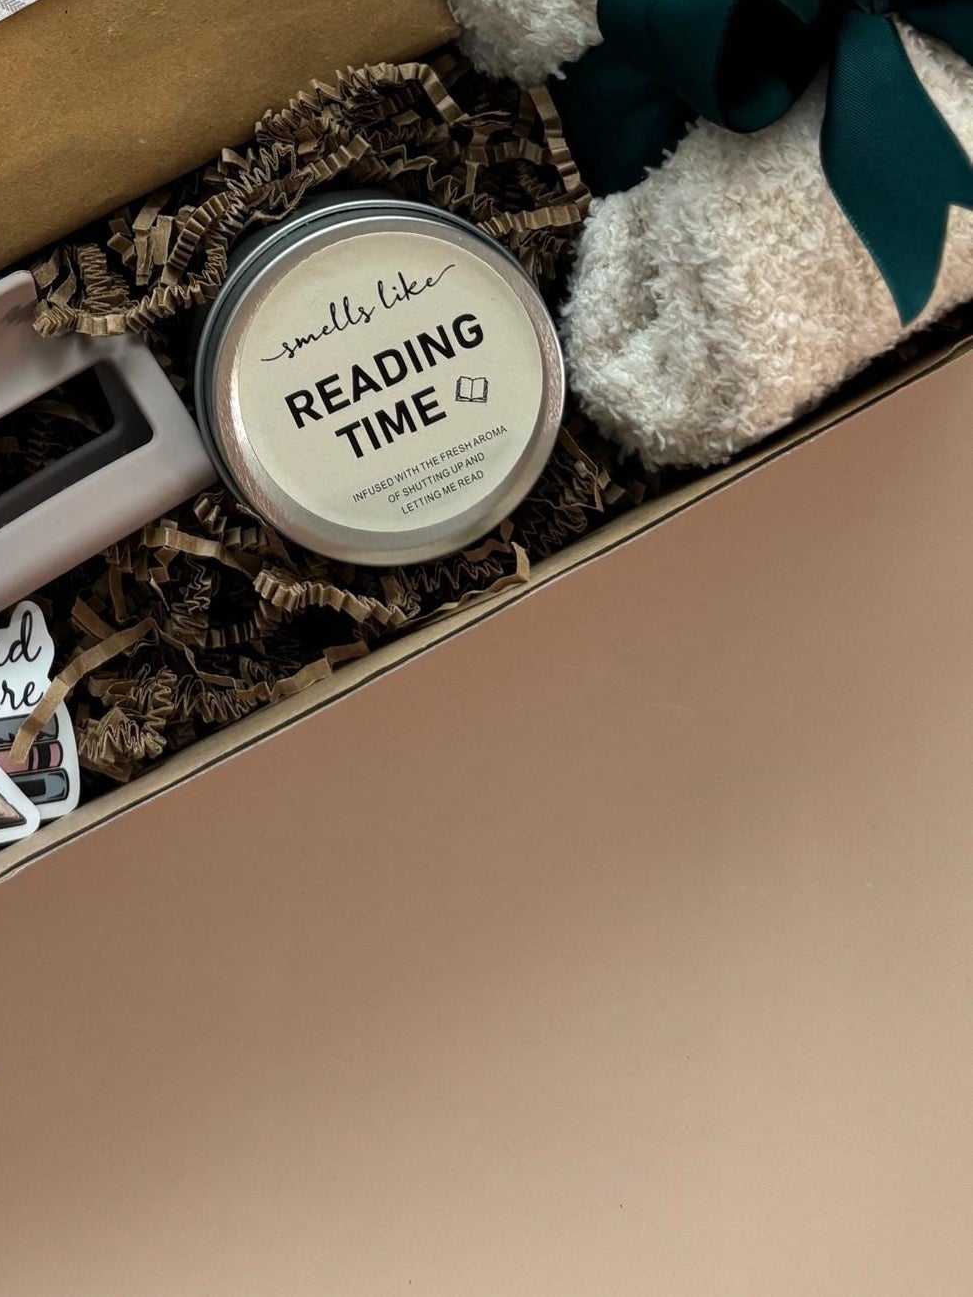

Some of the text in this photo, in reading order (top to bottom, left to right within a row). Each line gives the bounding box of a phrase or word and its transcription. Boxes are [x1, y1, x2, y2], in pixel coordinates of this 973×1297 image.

[261, 264, 455, 362] smells like
[284, 313, 484, 429] READING
[335, 386, 447, 459] TIME
[352, 425, 508, 502] INFUSED WITH THE FRESH AROMA
[388, 452, 485, 503] OF SHUTTING UP AND
[401, 470, 484, 514] LETTING ME READ
